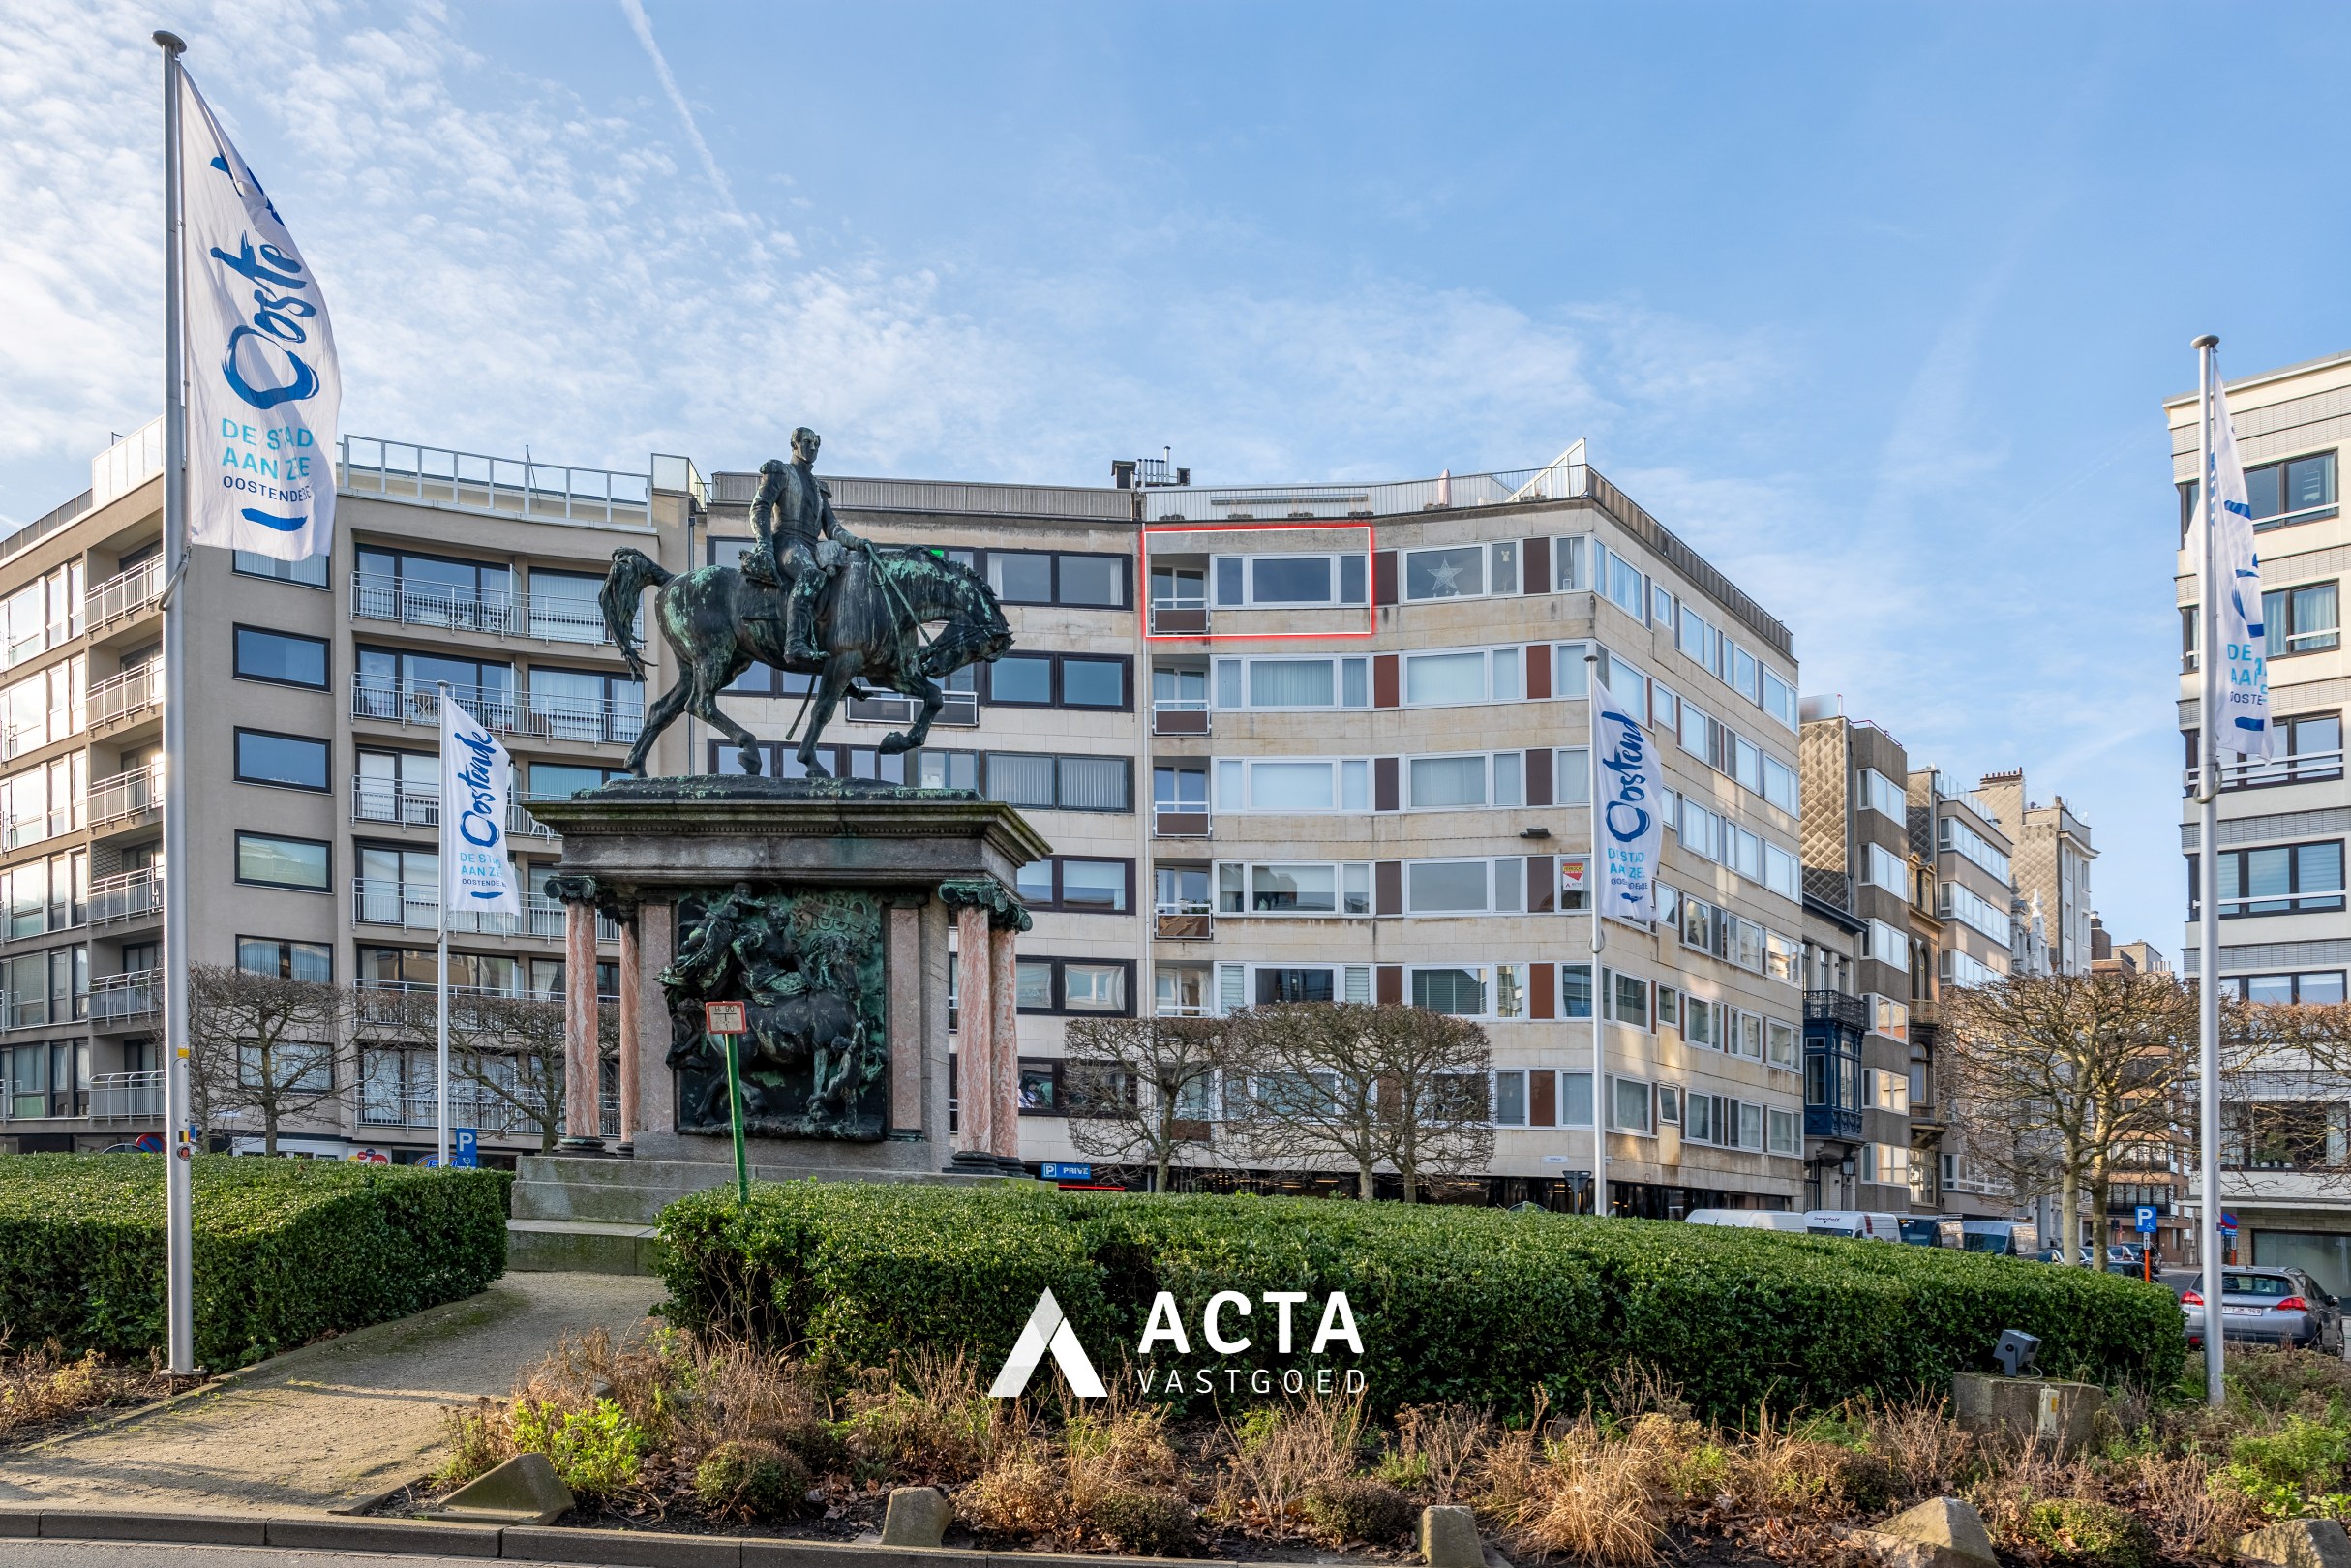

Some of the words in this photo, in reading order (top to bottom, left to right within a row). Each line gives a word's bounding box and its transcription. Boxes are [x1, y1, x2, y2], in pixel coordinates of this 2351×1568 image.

[222, 417, 256, 446] DE
[222, 447, 278, 479] AAN
[285, 457, 311, 481] ZE
[2227, 643, 2252, 661] DE
[1600, 710, 1650, 843] Oostend
[454, 731, 500, 848] Oostende
[460, 852, 475, 863] DE
[478, 853, 501, 869] STD
[1608, 847, 1620, 859] D
[461, 864, 486, 877] AAN
[462, 878, 507, 889] OOSTENDE.B
[459, 1132, 473, 1152] P
[2137, 1208, 2153, 1226] P
